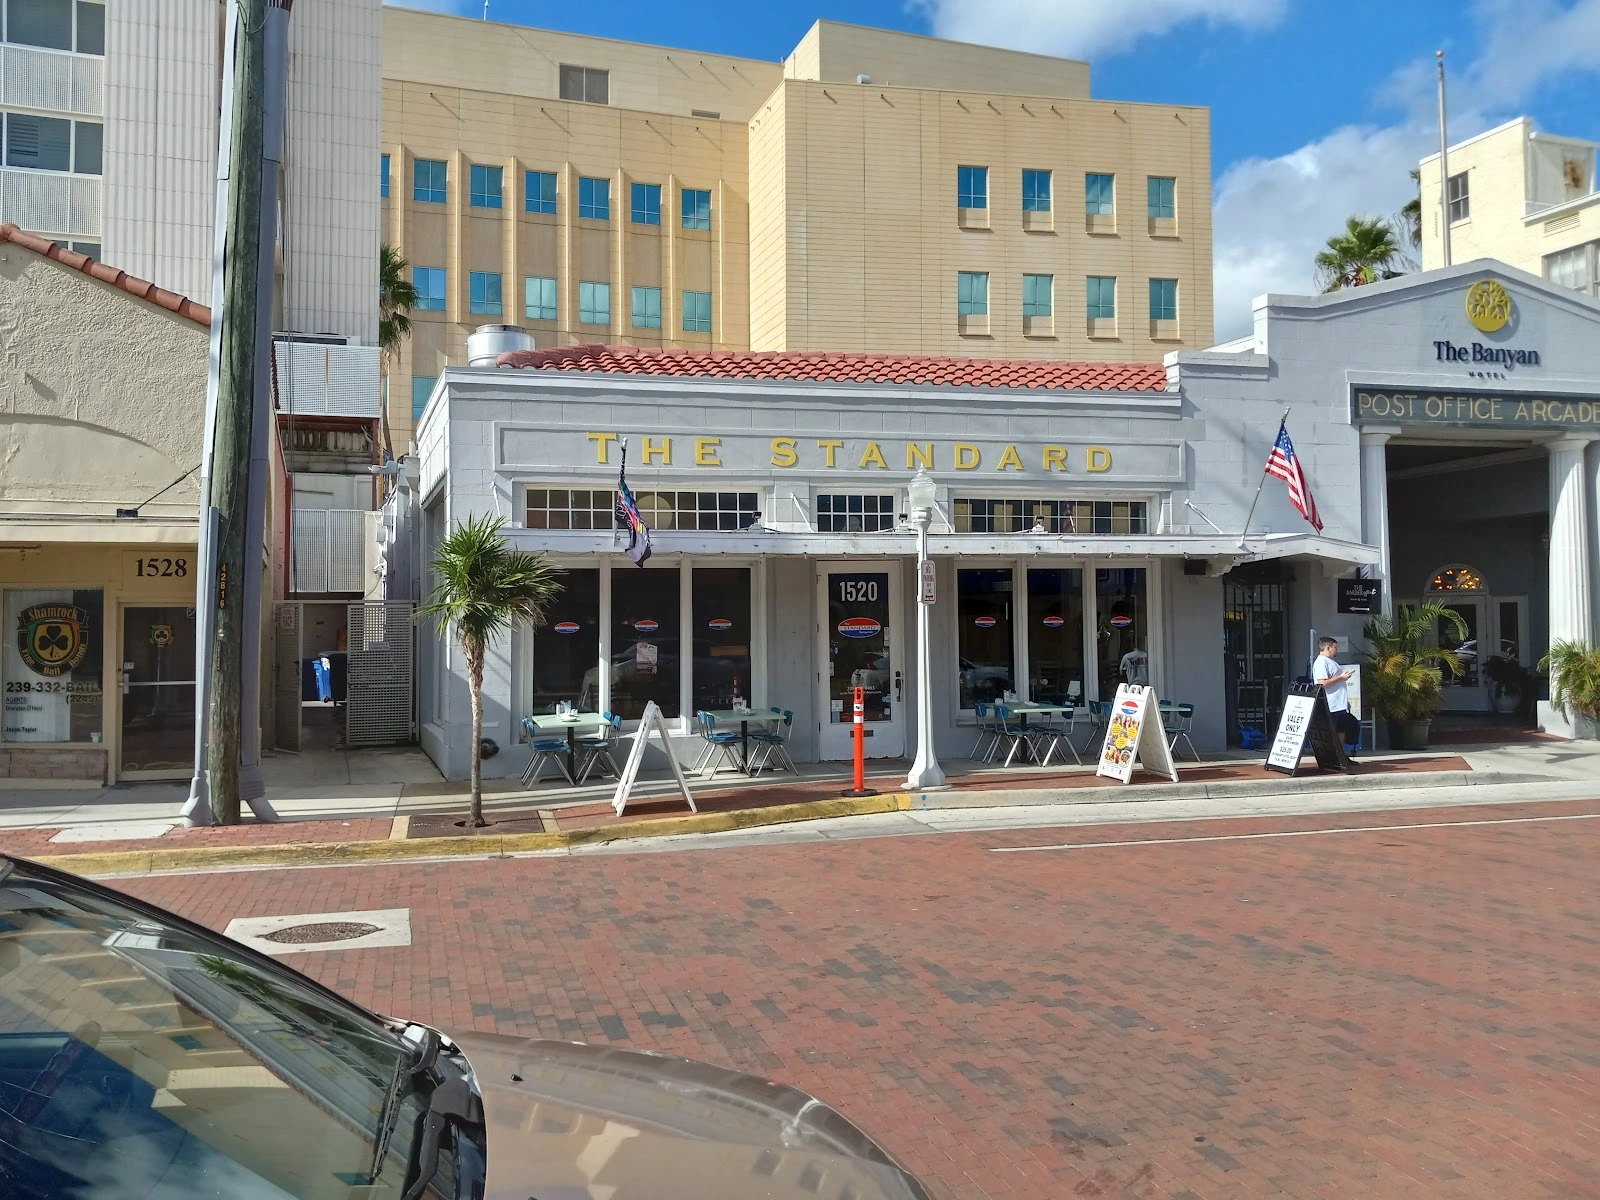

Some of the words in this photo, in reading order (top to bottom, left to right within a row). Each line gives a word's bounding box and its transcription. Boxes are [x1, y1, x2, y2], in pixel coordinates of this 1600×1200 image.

[1433, 341, 1469, 362] The
[1471, 342, 1541, 369] Banyan
[1358, 392, 1418, 417] POST
[1424, 395, 1504, 420] OFFICE
[1514, 399, 1600, 424] ARCADE
[586, 431, 722, 467] THE
[769, 436, 1114, 473] STANDARD
[136, 558, 187, 577] 1528
[840, 581, 878, 602] 1520
[28, 607, 78, 621] Shamrock
[43, 667, 61, 675] Bail
[6, 681, 99, 693] 239-332-BAIL
[66, 694, 98, 705] (2245)
[1287, 715, 1304, 724] VALET
[1285, 724, 1301, 733] ONLY
